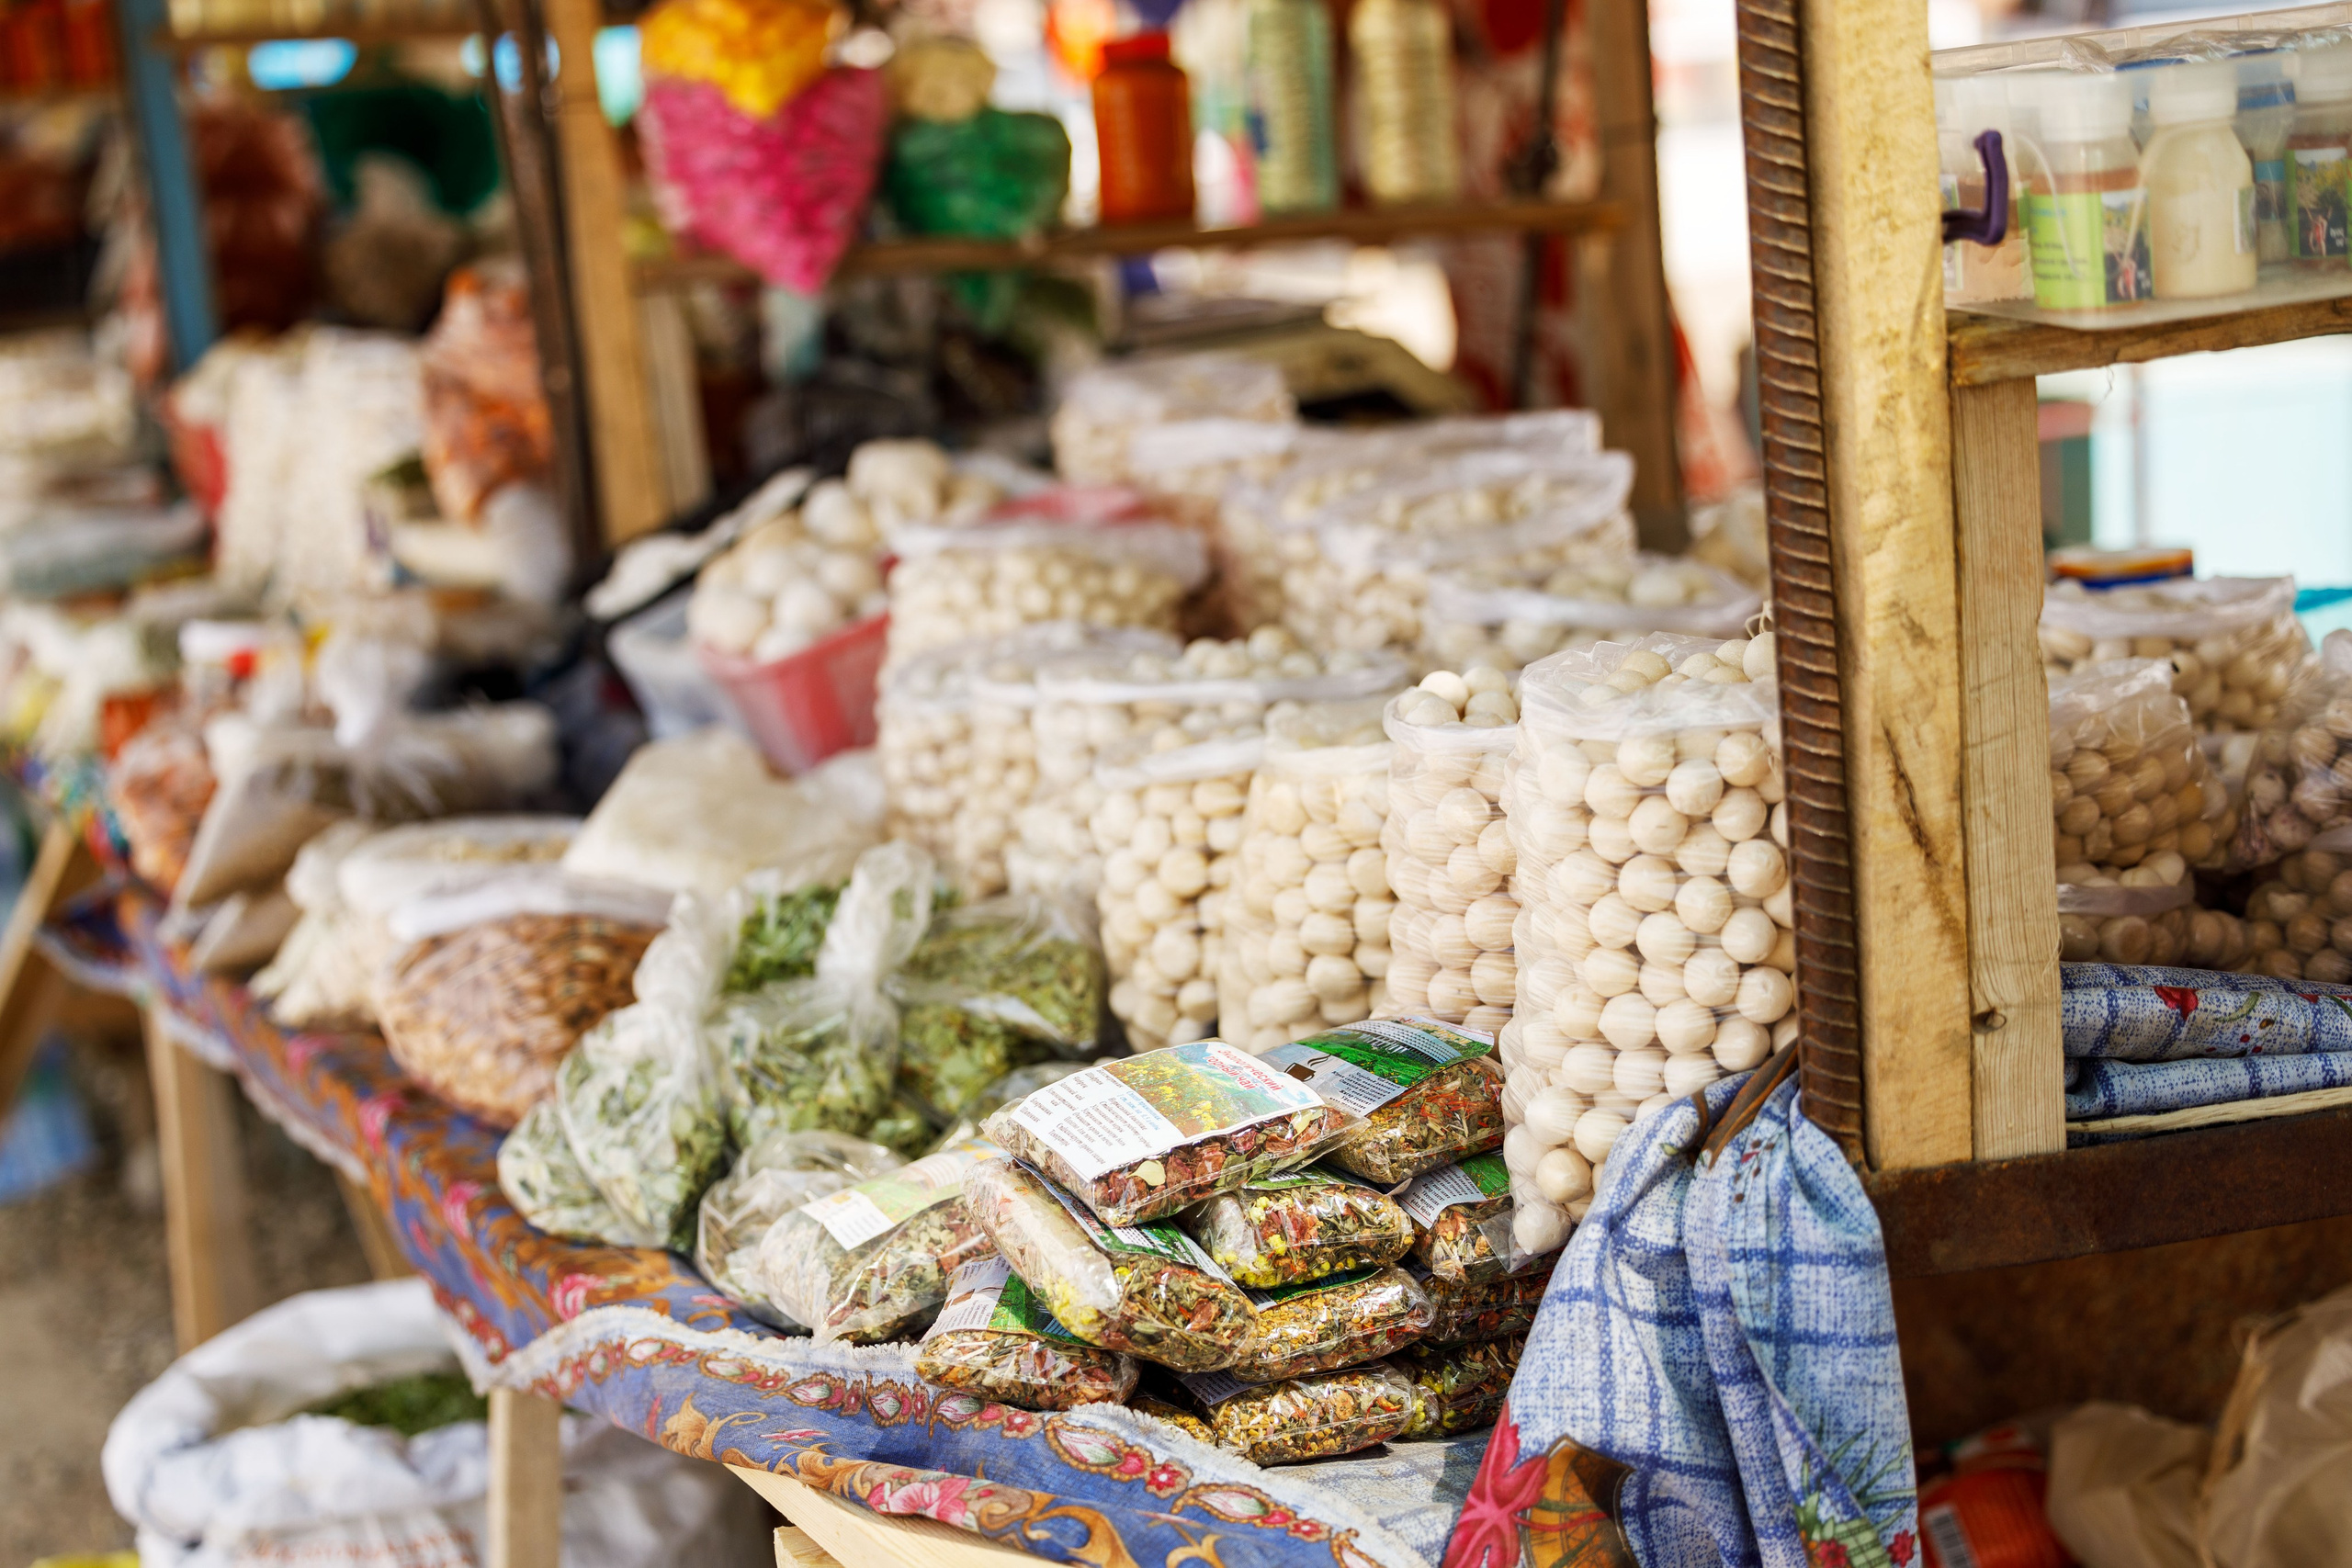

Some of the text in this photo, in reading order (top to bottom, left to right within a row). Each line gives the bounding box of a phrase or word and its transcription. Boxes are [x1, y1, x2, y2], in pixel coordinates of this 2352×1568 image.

[1204, 1055, 1259, 1090] горный чай
[1218, 1049, 1284, 1091] Экологический
